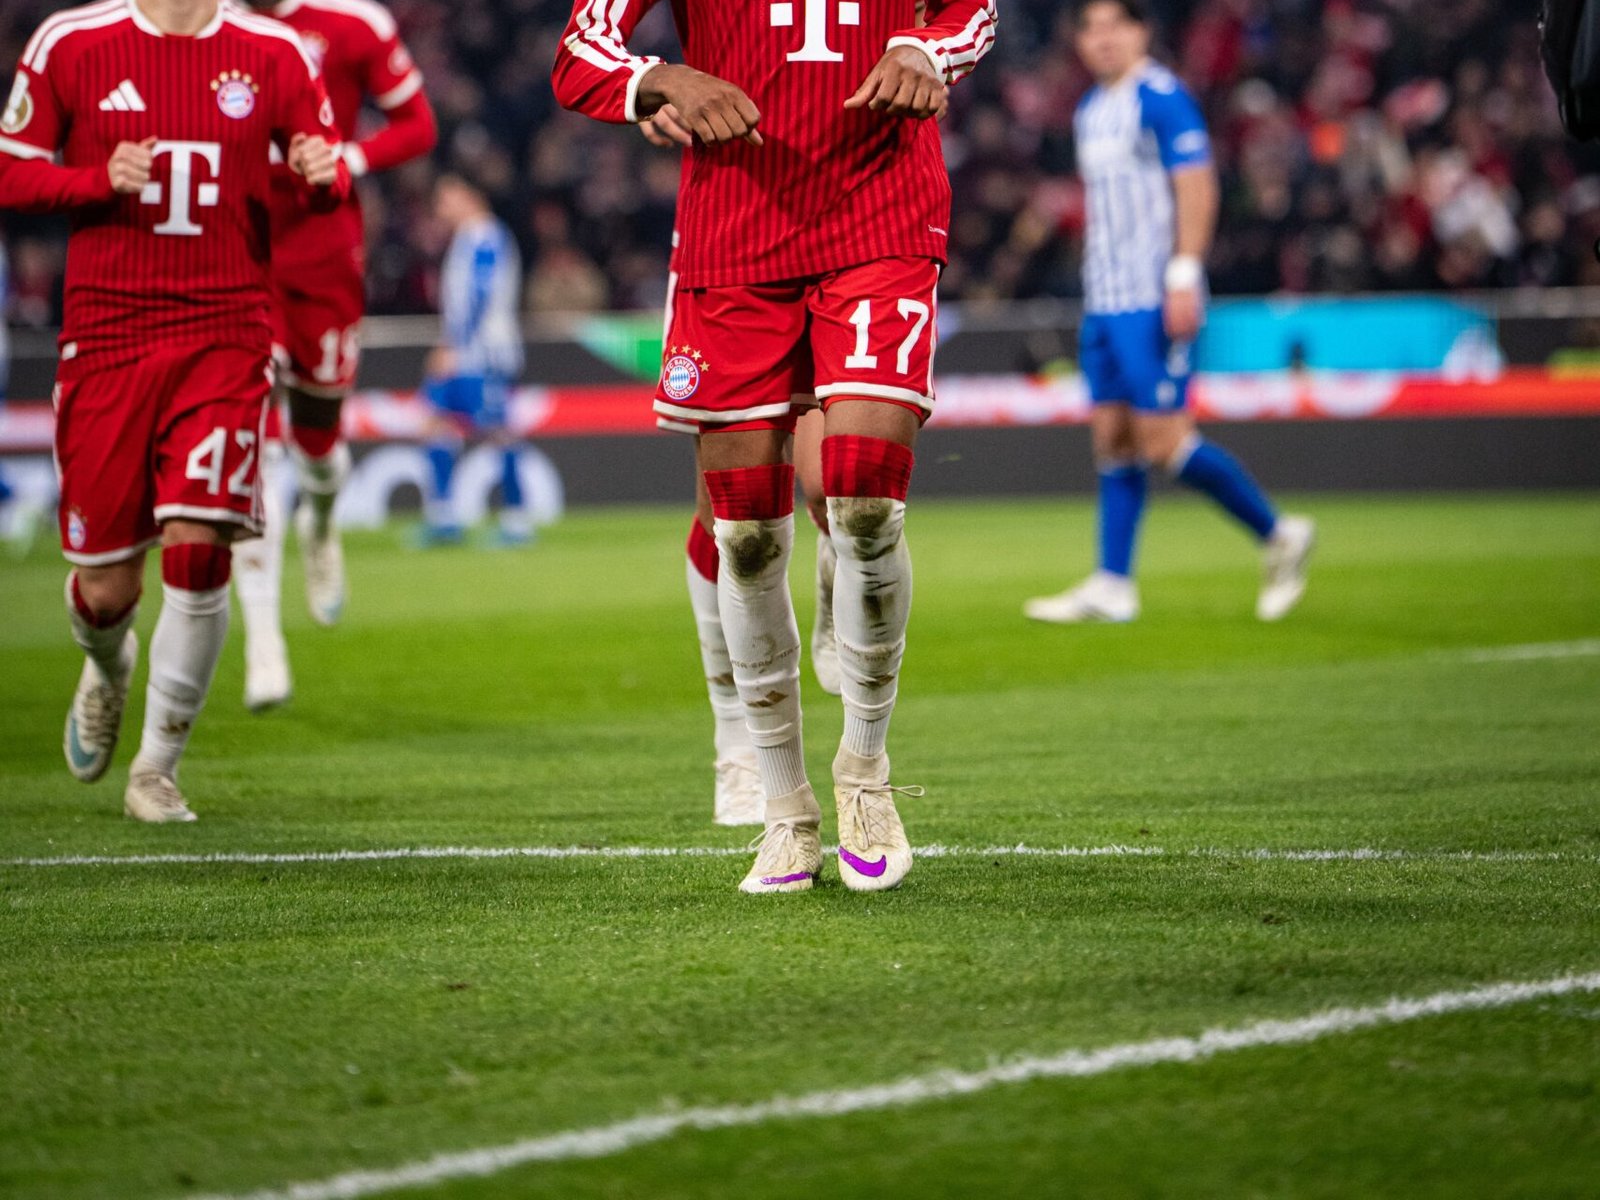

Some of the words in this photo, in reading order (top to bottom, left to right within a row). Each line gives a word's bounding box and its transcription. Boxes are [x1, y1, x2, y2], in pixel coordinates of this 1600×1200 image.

[140, 140, 221, 236] T
[674, 359, 696, 378] BAYERN
[845, 298, 929, 375] 17
[185, 427, 256, 497] 42
